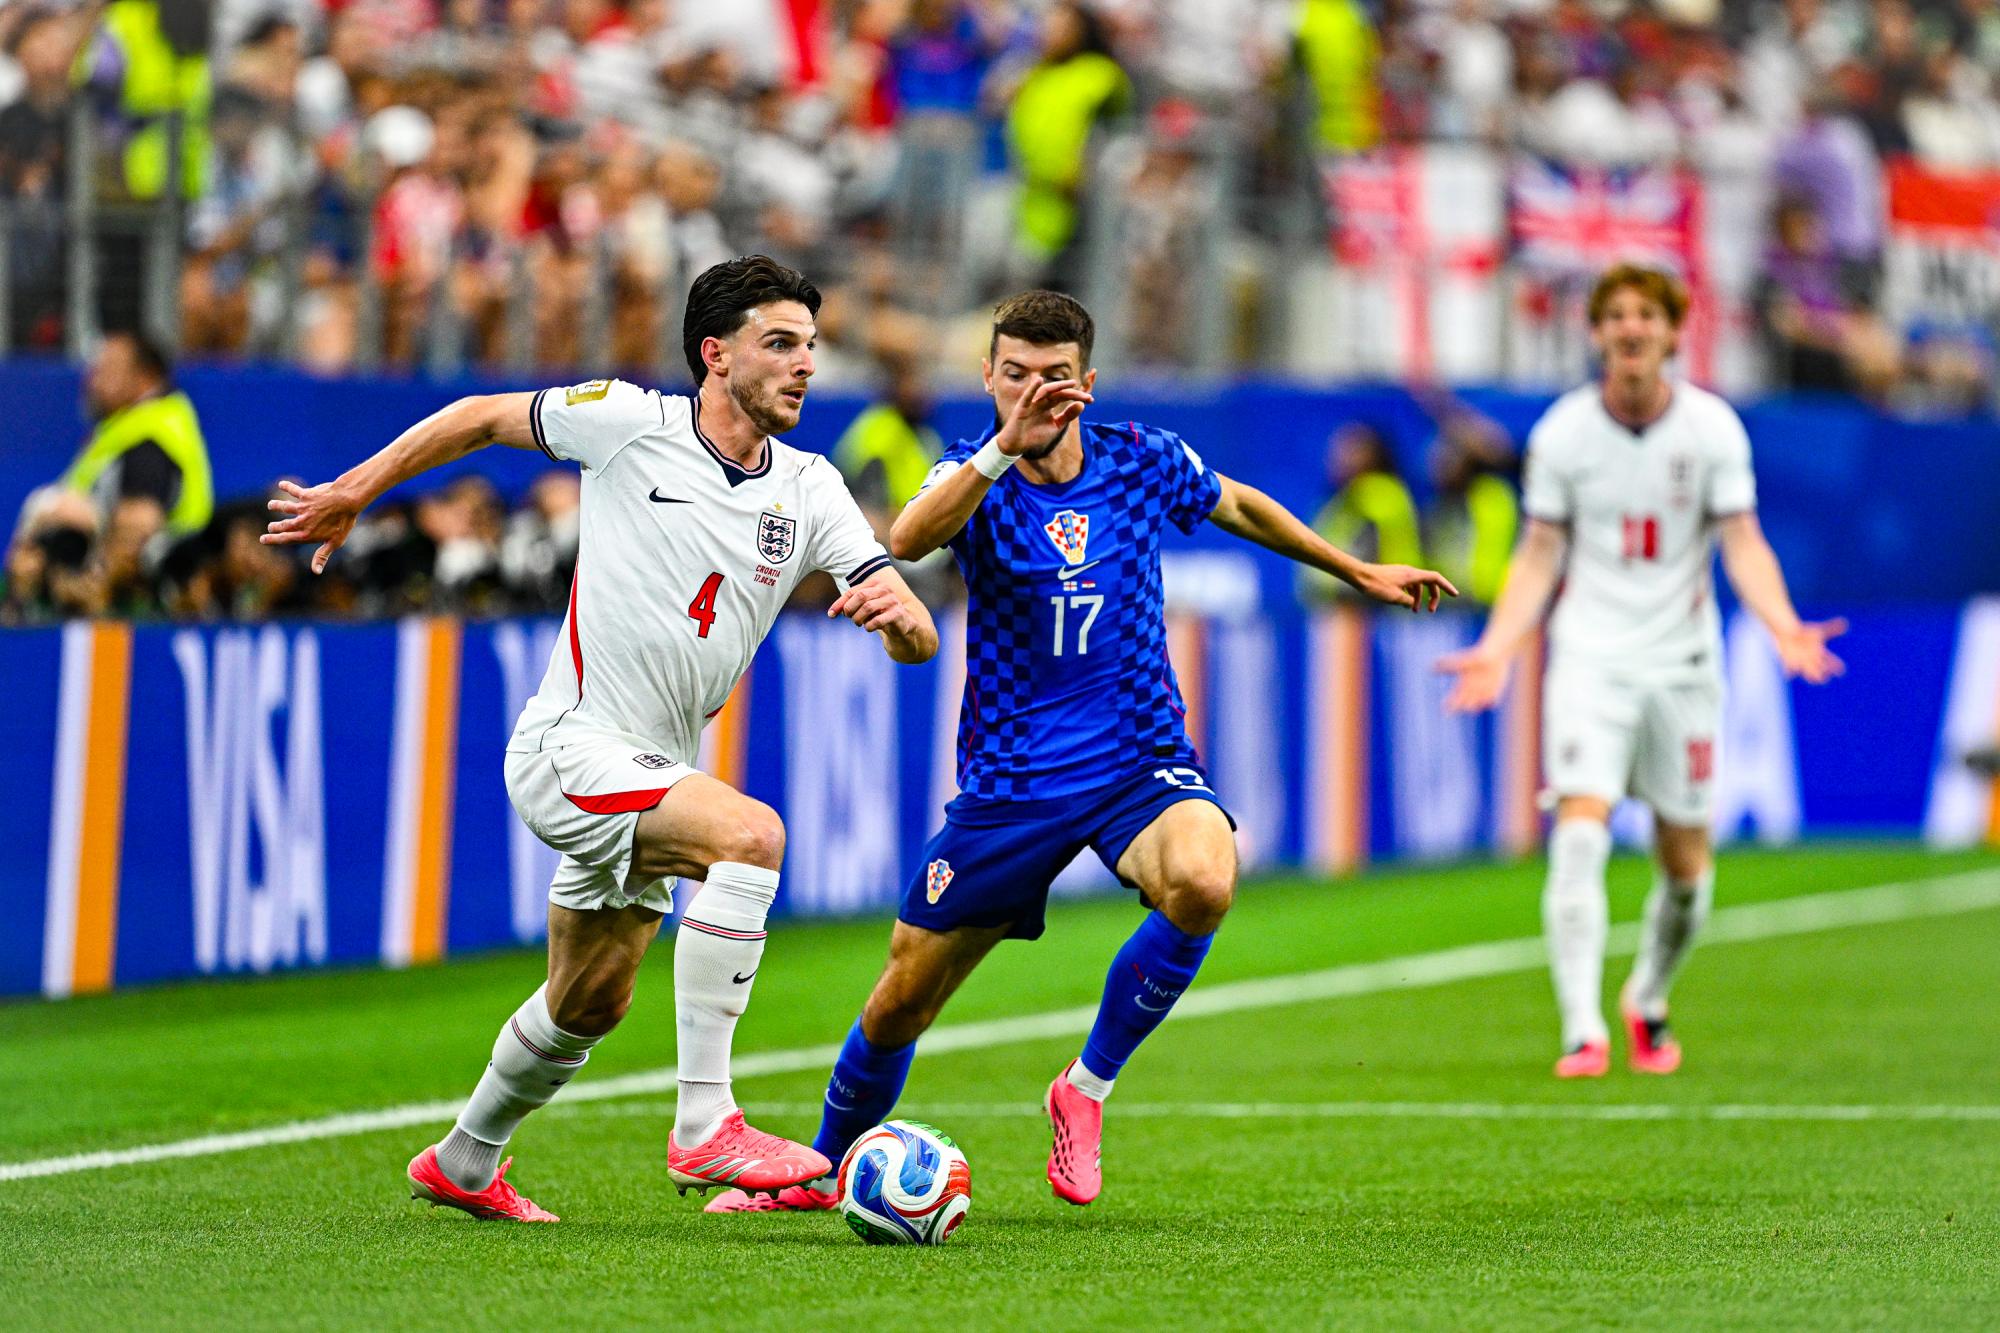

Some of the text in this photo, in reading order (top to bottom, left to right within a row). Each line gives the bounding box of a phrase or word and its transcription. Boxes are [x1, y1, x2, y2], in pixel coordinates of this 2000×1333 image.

[755, 564, 781, 578] CROATIA
[688, 571, 725, 639] 4
[1051, 594, 1105, 656] 17
[173, 624, 328, 973] VISA
